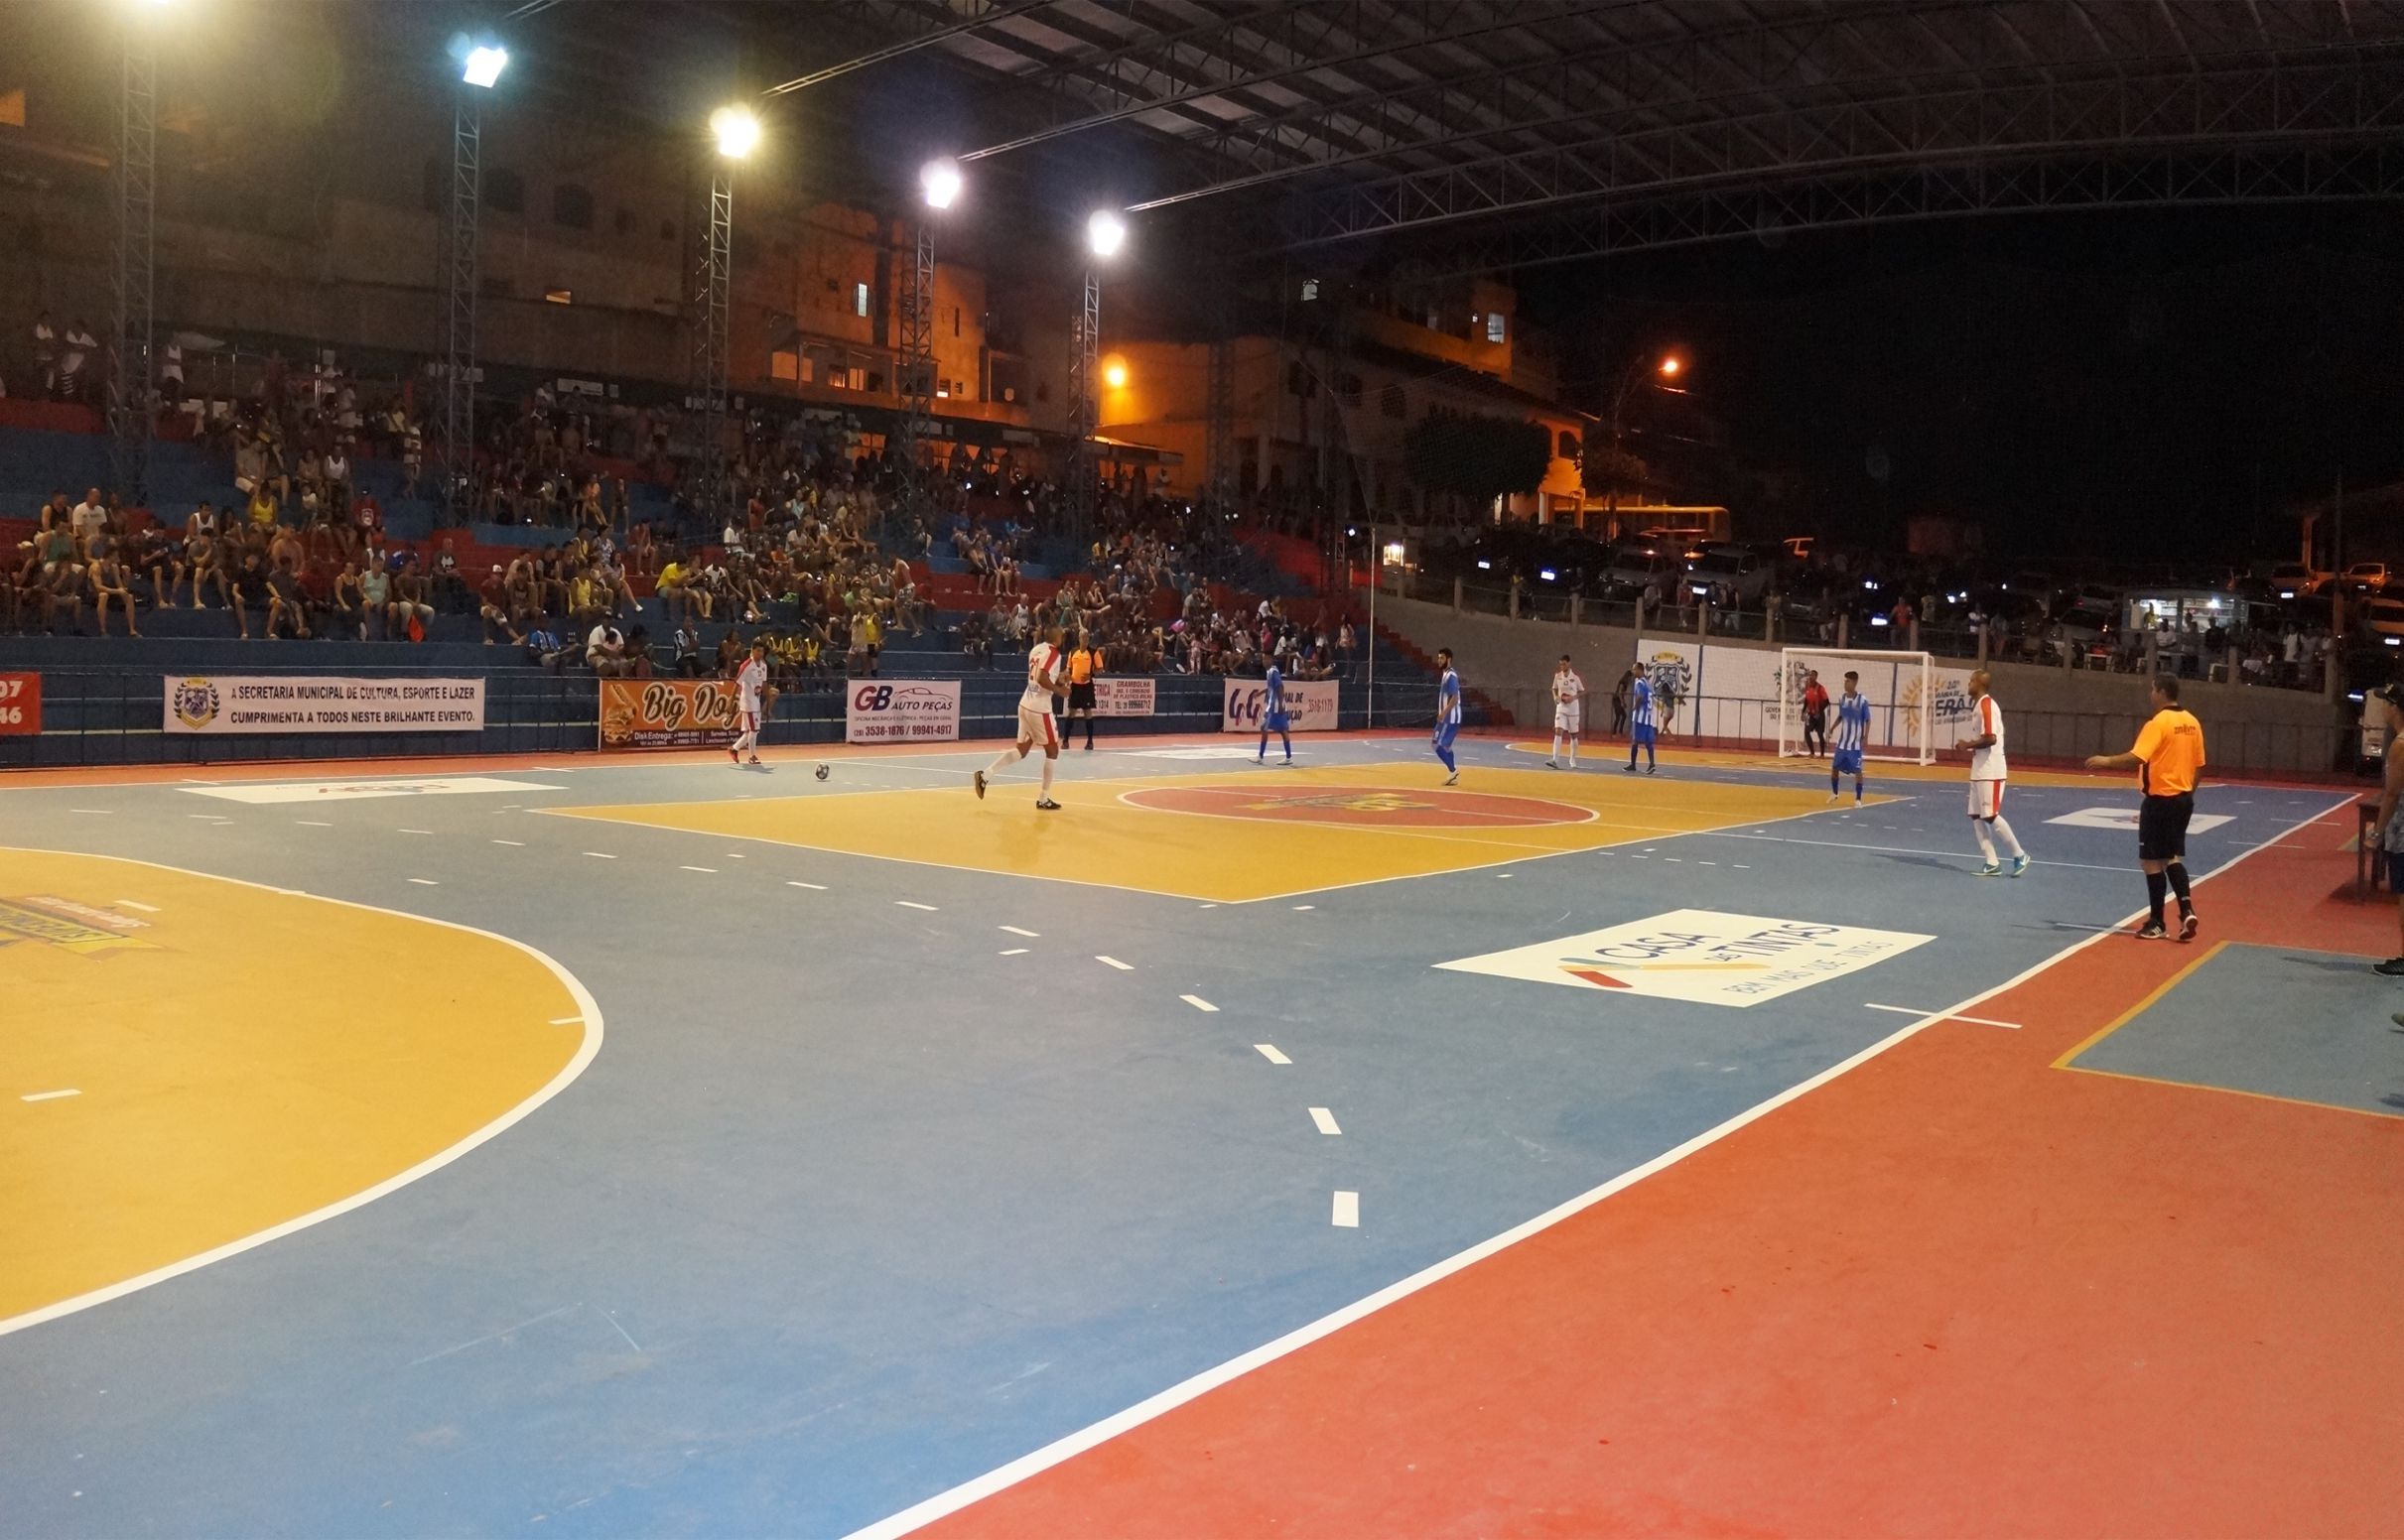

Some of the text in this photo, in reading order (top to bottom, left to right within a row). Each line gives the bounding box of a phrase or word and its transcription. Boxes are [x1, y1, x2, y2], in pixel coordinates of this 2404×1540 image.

[231, 686, 474, 701] A SECRETARIA MUNICIPAL DE CULTURA, ESPORTE E LAZER
[855, 686, 893, 710] GB
[230, 710, 474, 723] CUMPRIMENTA A TODOS NESTE BRILHANTE EVENTO.
[642, 682, 688, 731] Big
[891, 702, 953, 712] AUTO PEÇAS
[1595, 932, 1721, 960] CASA
[1707, 924, 1840, 957] TINTAS
